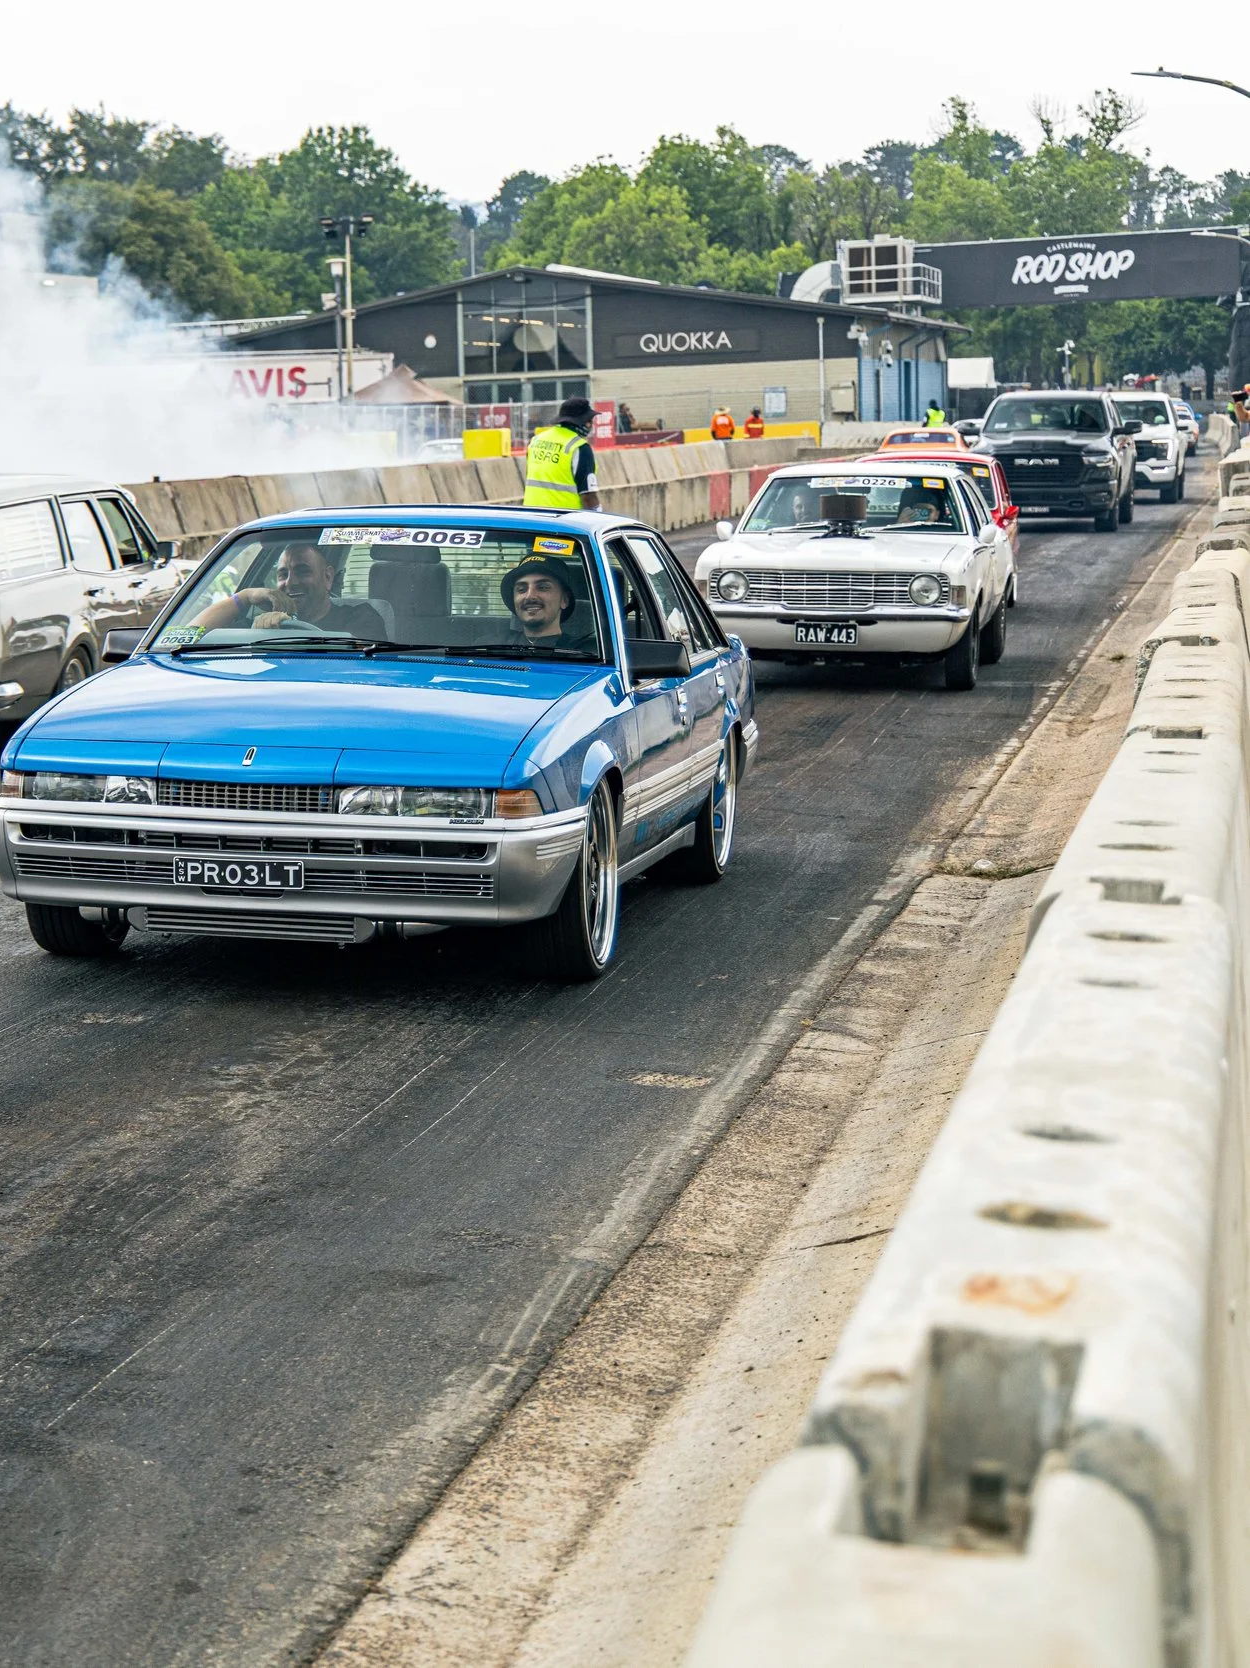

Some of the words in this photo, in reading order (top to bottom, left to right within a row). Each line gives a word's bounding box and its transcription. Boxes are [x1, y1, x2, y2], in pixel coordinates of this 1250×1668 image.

[1046, 241, 1097, 253] CASTLEMAINE
[1011, 254, 1066, 285] ROD
[1065, 249, 1135, 281] SHOP
[639, 330, 733, 353] QUOKKA
[227, 366, 307, 398] AVIS
[531, 437, 563, 453] SECURITY
[1013, 458, 1059, 466] RAM
[862, 478, 896, 486] 0226
[411, 531, 483, 546] 0063
[160, 636, 194, 644] 0063
